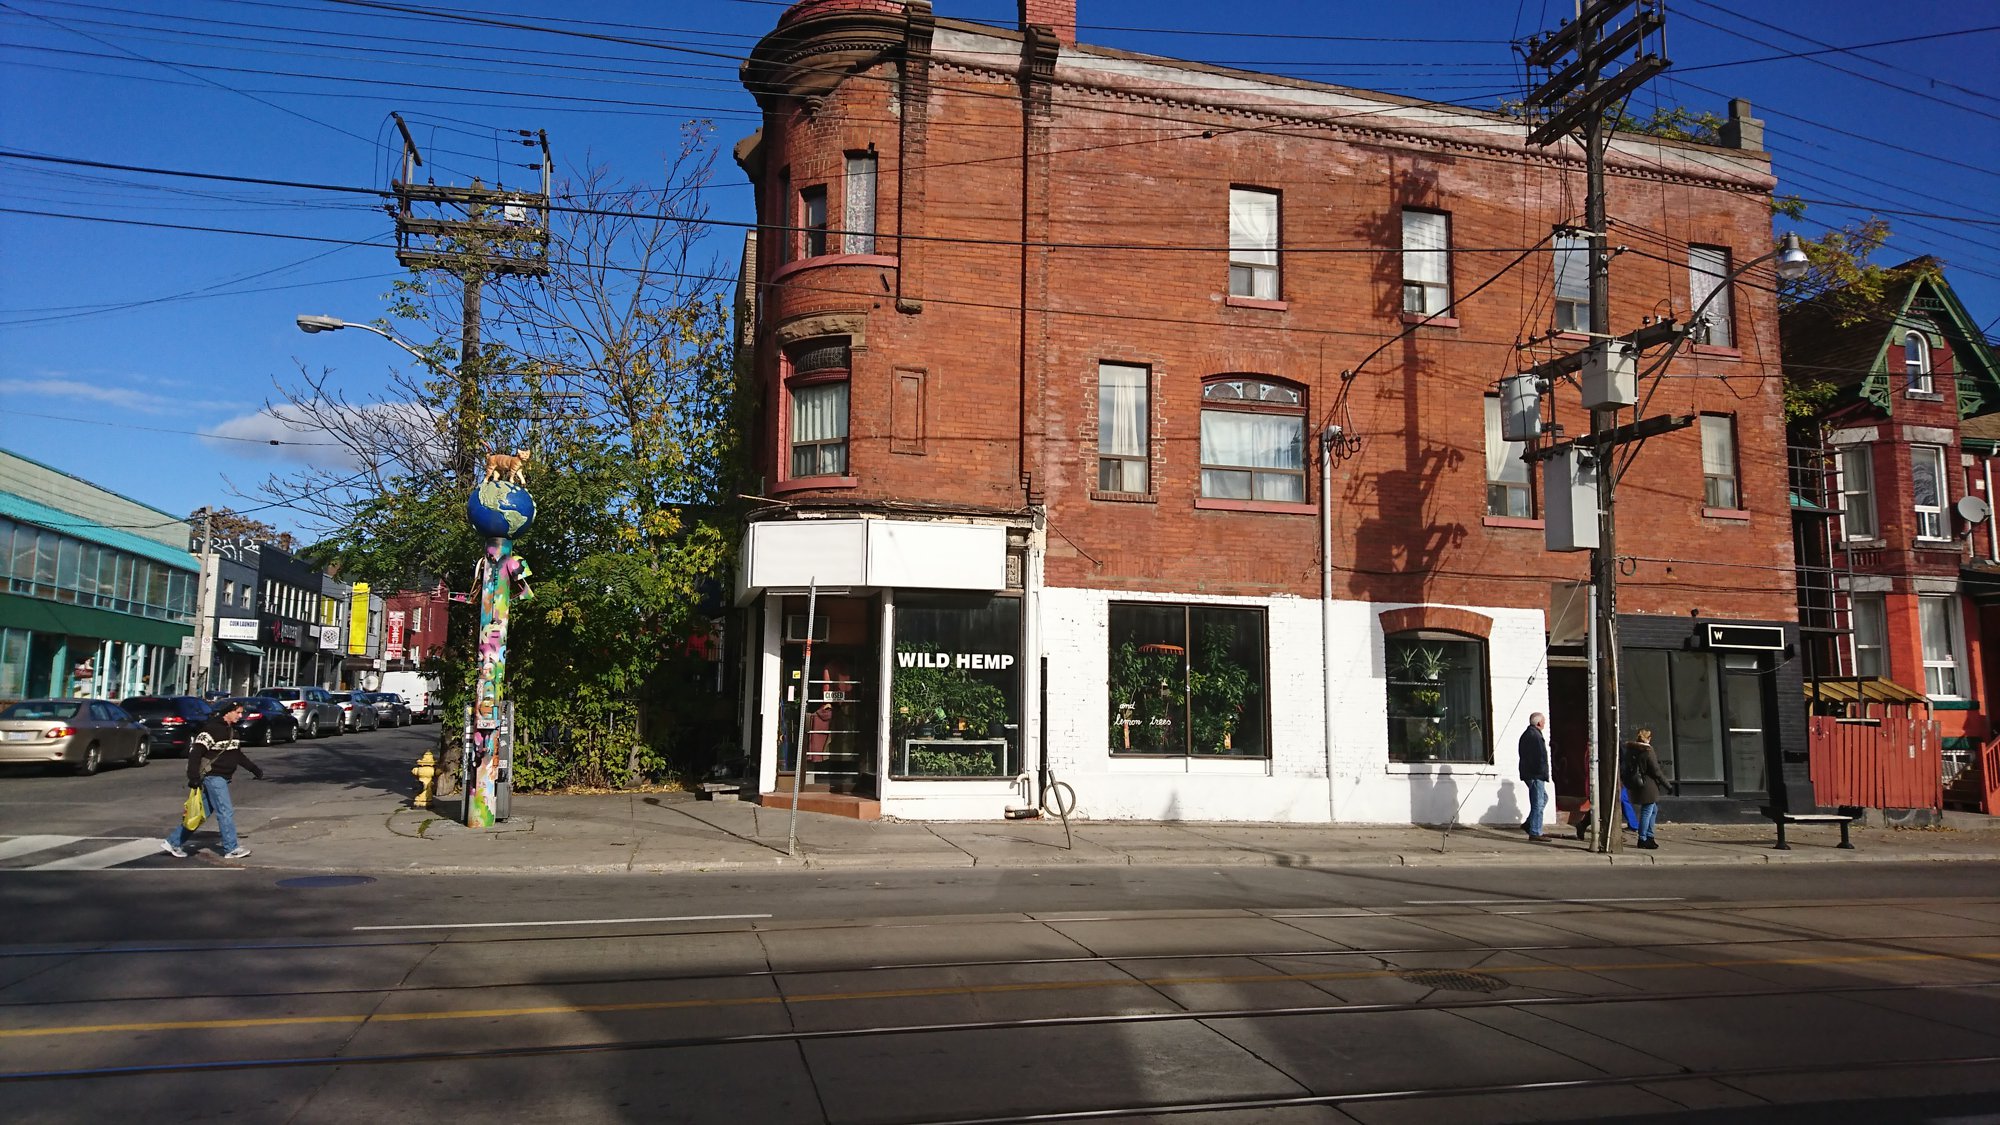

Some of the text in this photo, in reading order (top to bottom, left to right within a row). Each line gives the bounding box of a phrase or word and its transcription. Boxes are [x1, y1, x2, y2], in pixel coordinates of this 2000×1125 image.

[1713, 630, 1724, 641] W
[897, 652, 1015, 670] WILD HEMP
[1119, 701, 1136, 710] and
[1113, 713, 1172, 726] lemon trees
